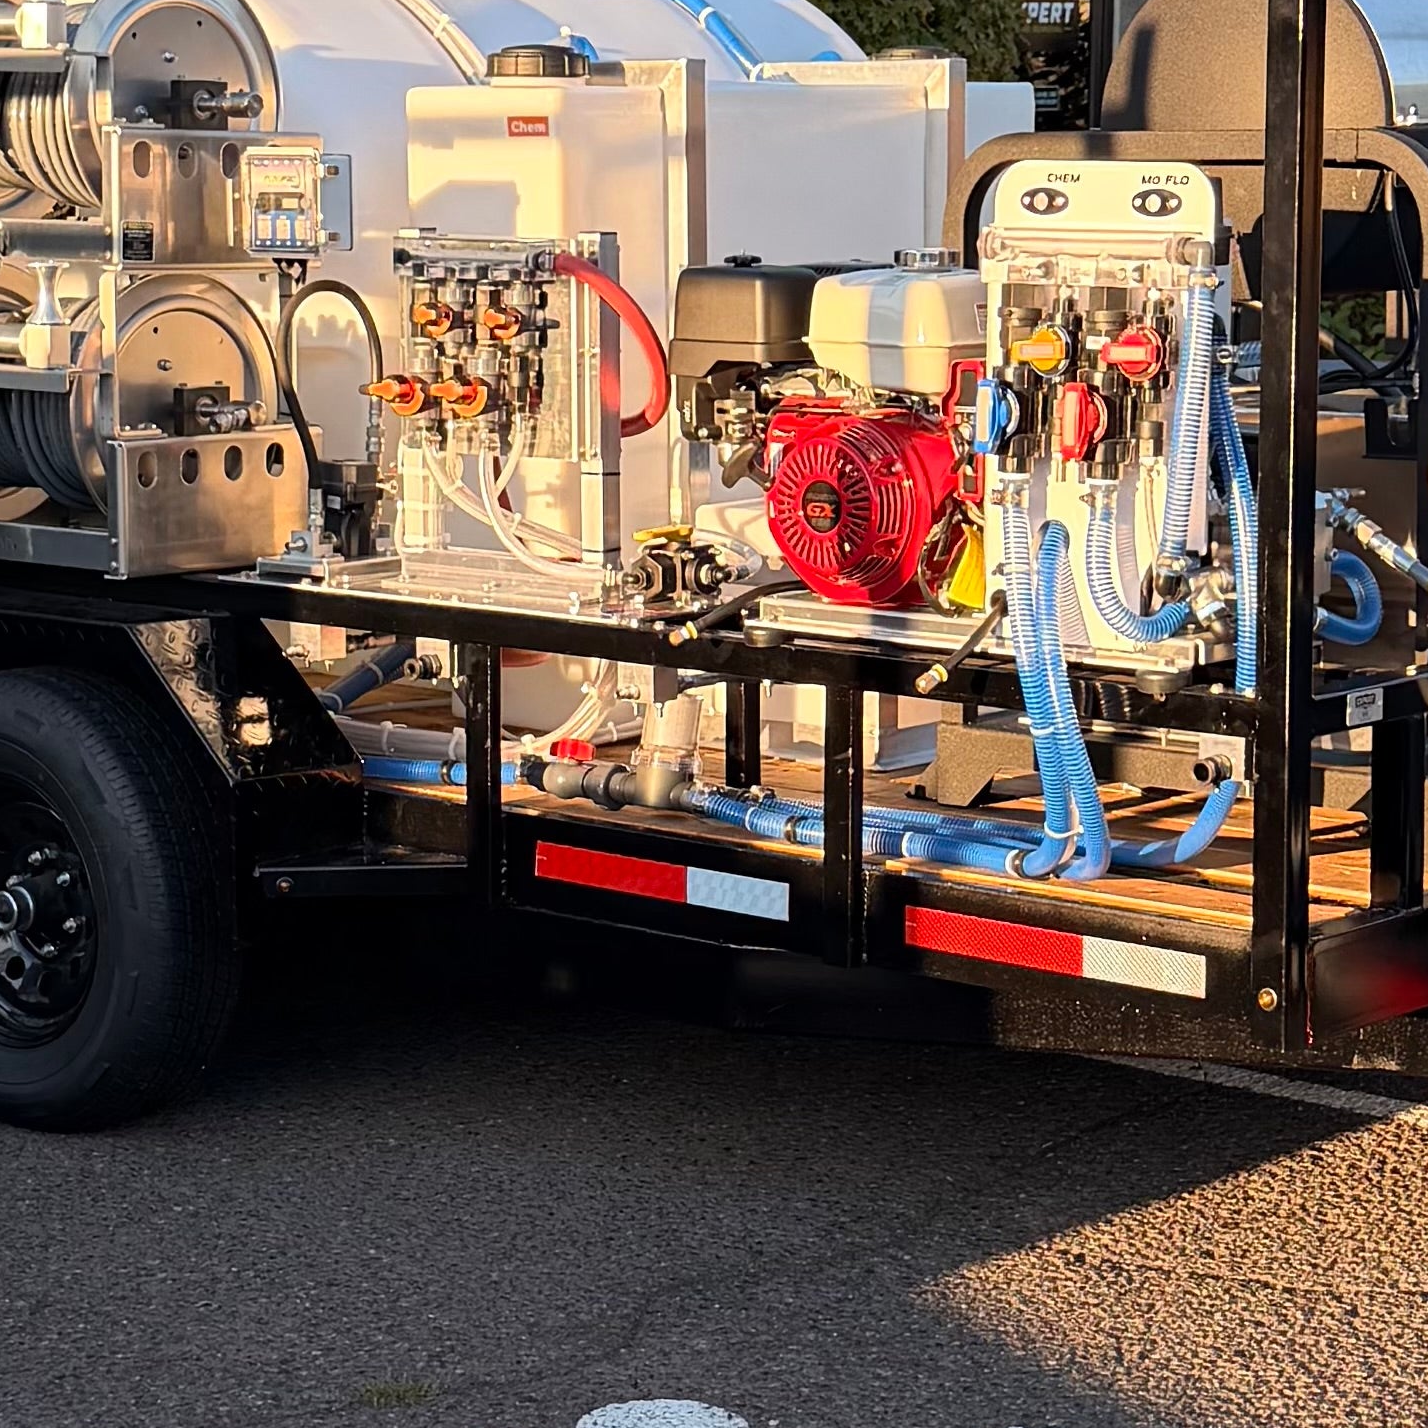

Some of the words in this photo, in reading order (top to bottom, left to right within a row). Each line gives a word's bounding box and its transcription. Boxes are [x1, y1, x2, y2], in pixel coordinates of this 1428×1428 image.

[511, 120, 546, 132] Chem
[1047, 173, 1081, 183] CHEM
[1142, 175, 1161, 185] MO
[1165, 175, 1190, 185] FLO
